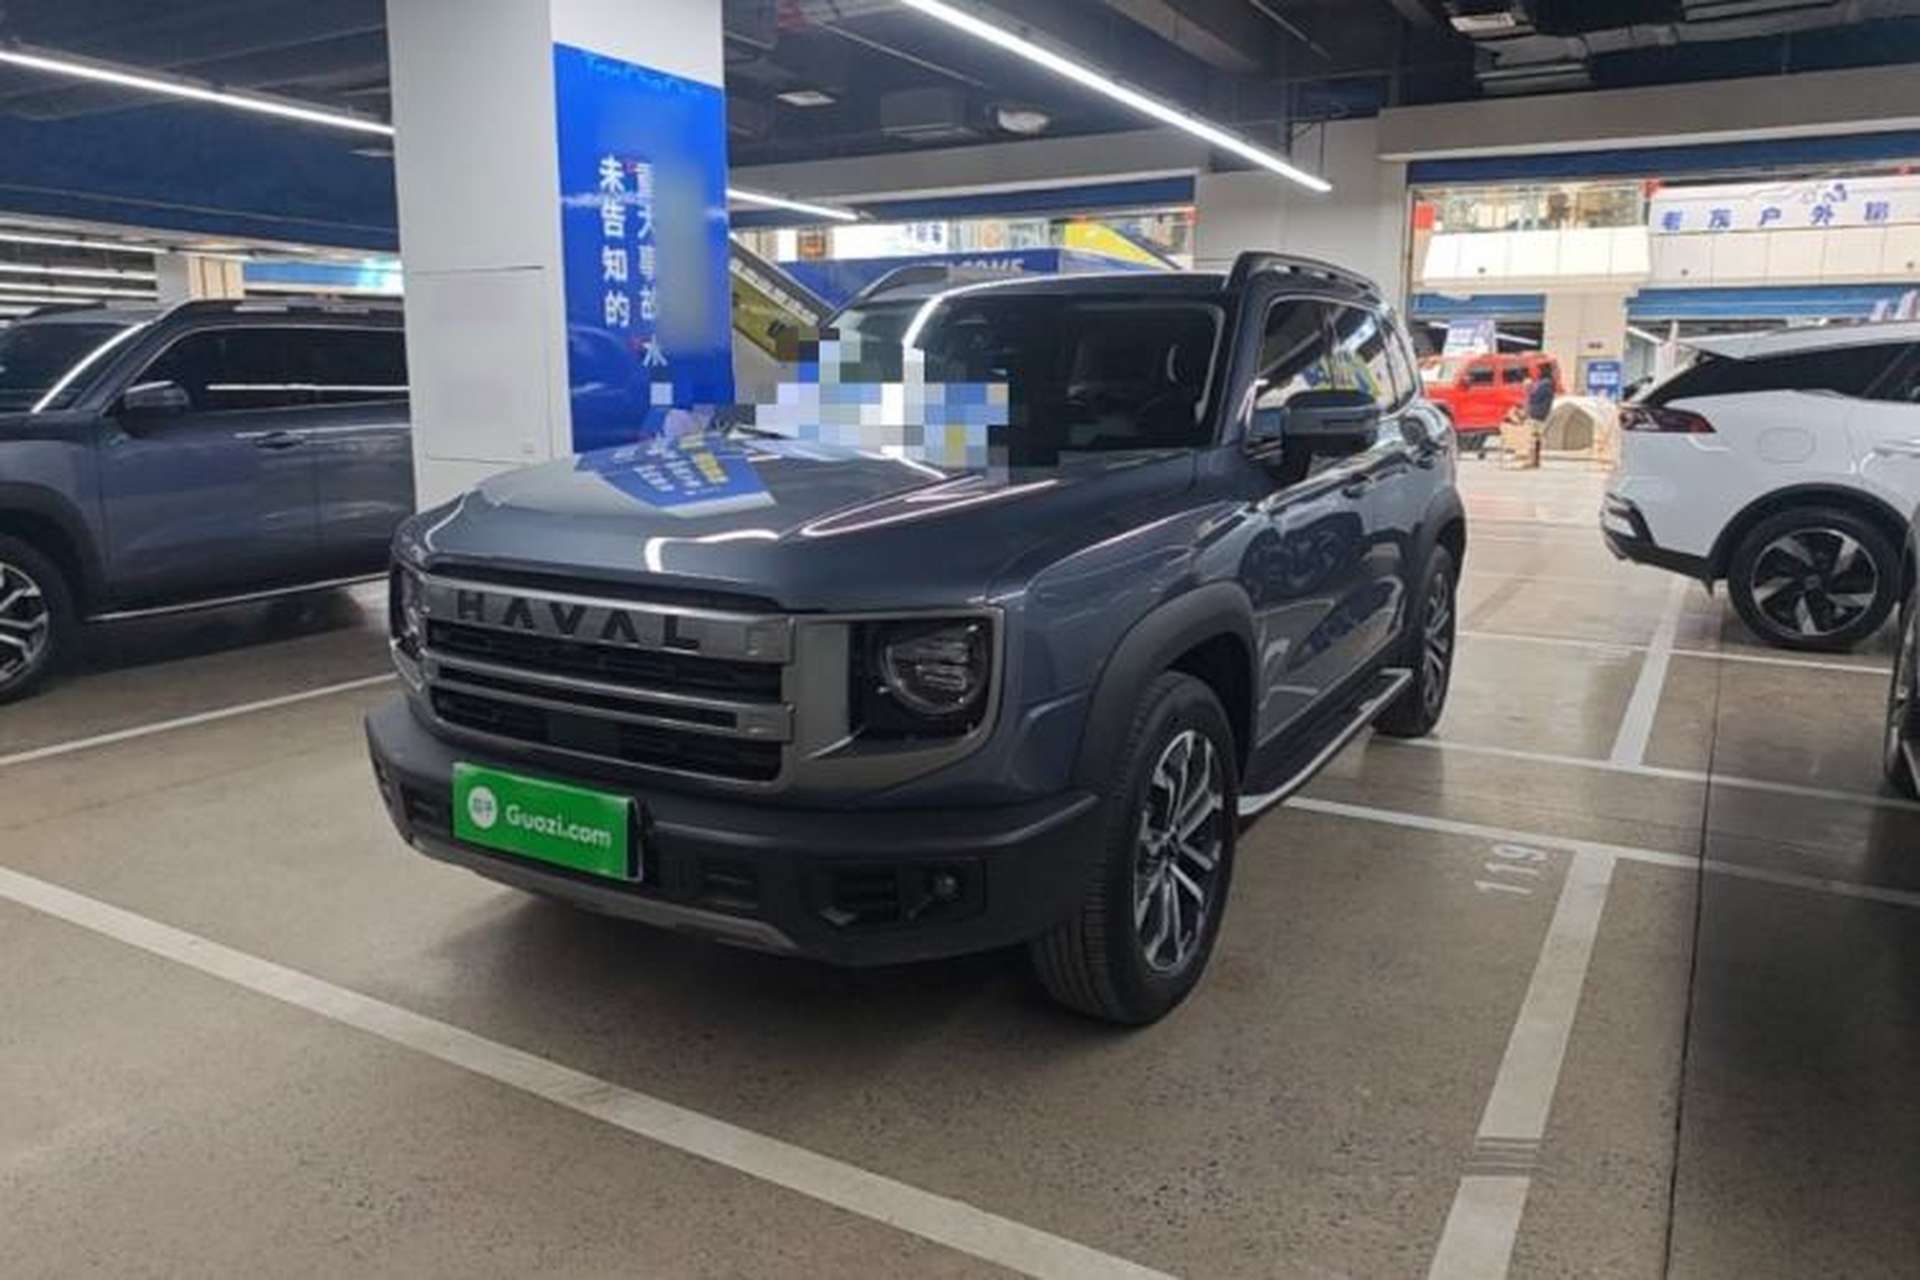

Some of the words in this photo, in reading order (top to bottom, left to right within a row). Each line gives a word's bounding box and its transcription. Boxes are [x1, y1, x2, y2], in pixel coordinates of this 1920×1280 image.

[599, 154, 630, 328] 未告知的
[458, 588, 699, 650] HAVAL
